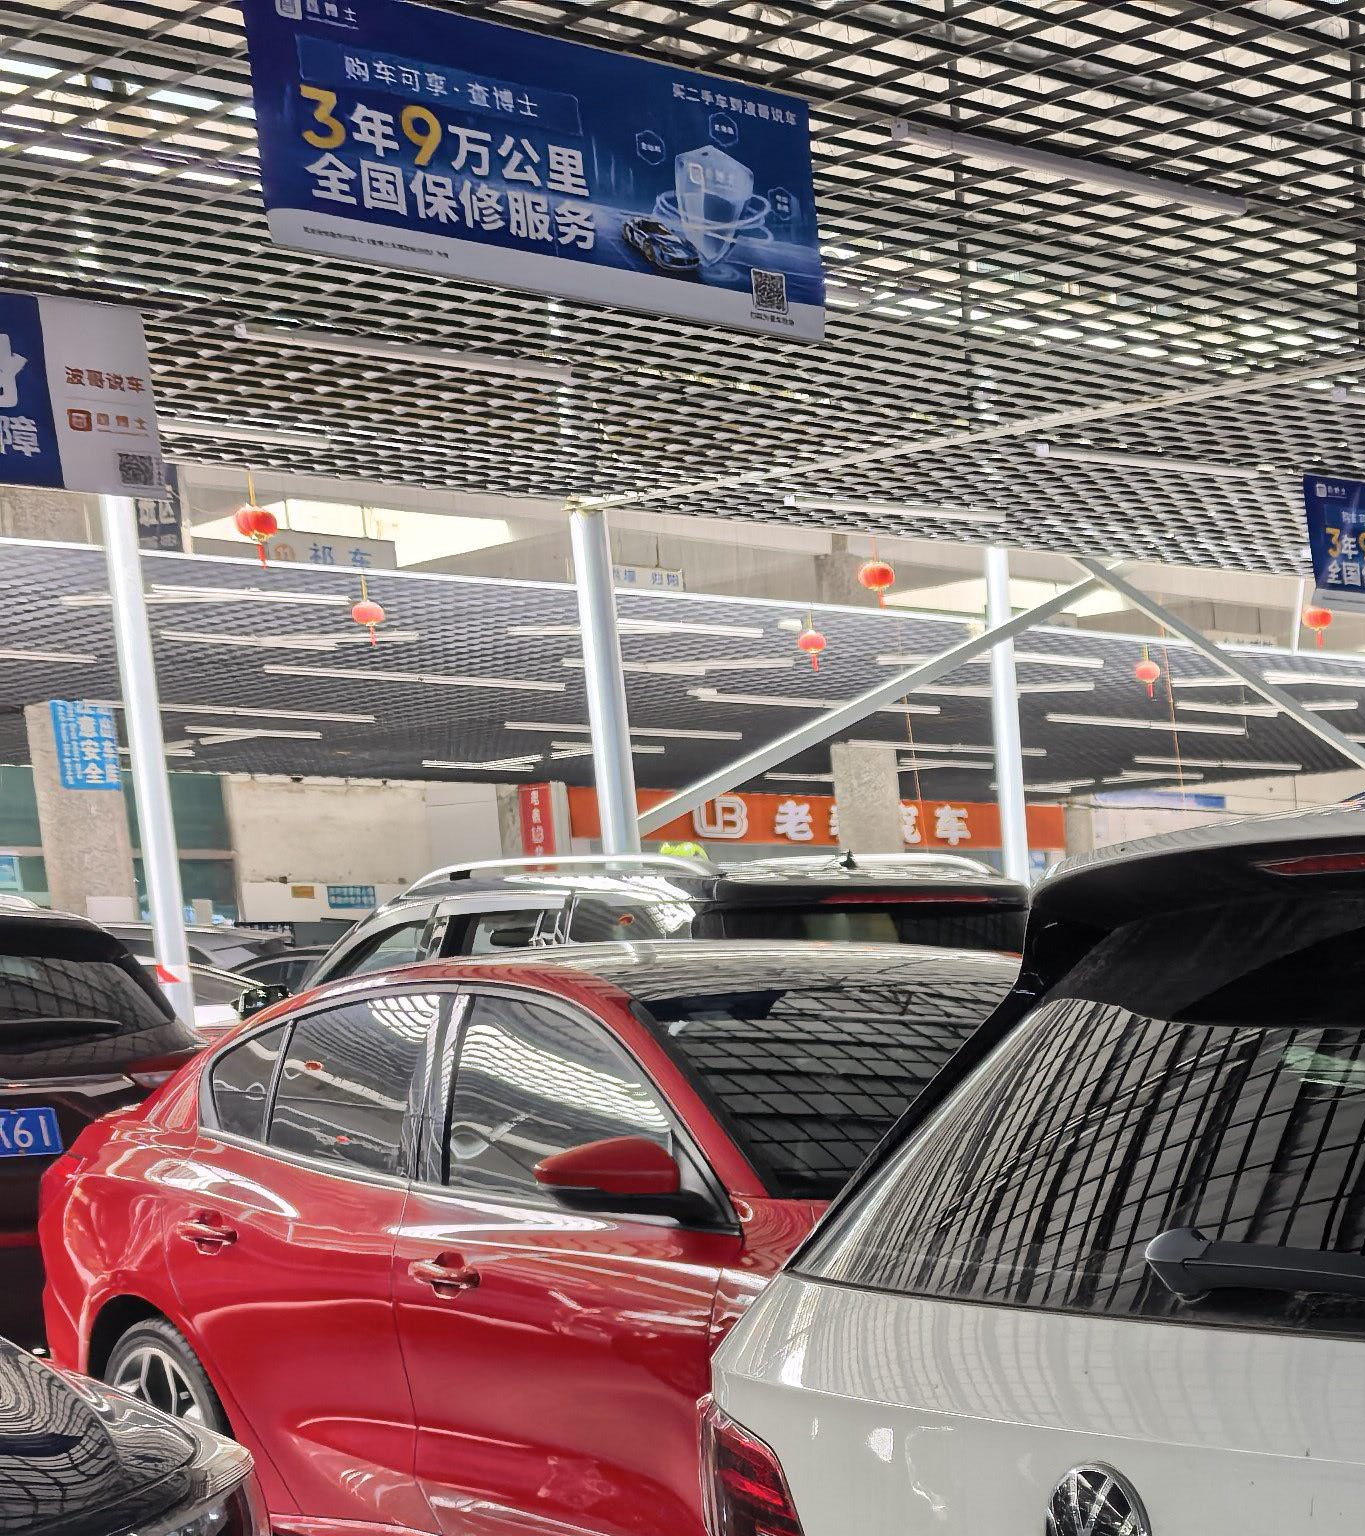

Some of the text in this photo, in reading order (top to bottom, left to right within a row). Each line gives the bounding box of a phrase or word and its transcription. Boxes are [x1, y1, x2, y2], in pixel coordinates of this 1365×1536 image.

[301, 86, 590, 198] 3年9万公里
[306, 153, 596, 250] 全国保修服务
